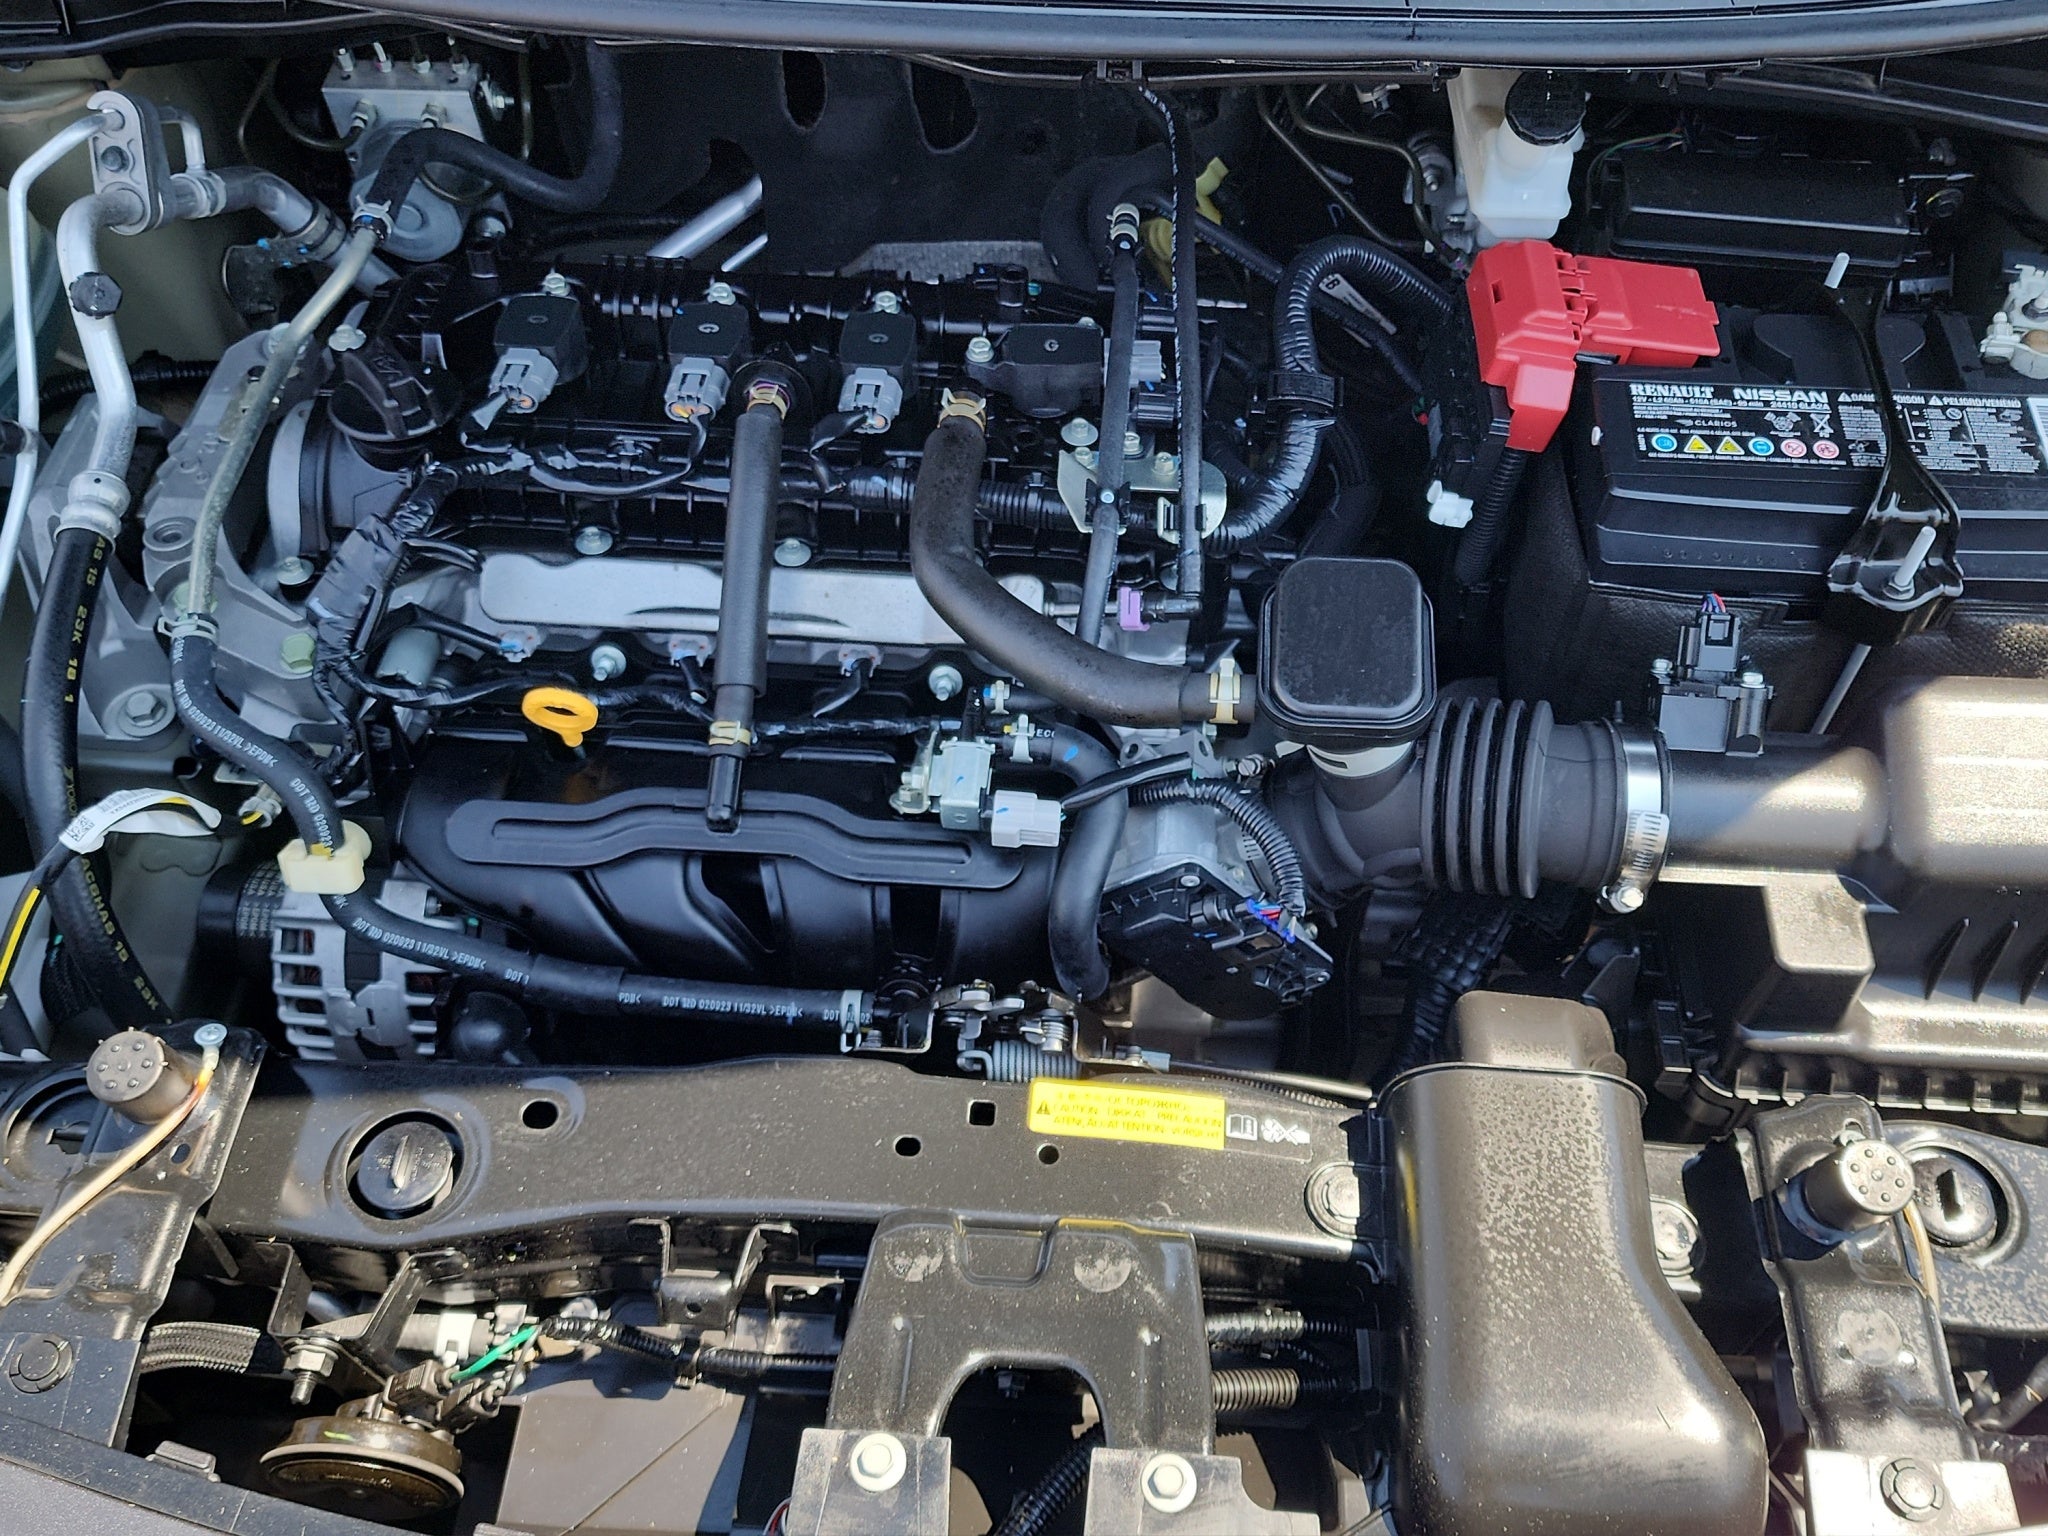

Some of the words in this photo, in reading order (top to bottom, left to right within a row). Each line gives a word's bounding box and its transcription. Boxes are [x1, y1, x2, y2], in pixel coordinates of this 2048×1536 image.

[1630, 383, 1714, 398] RENAULT
[1732, 387, 1828, 403] NISSAN
[71, 605, 88, 644] 23K
[289, 777, 310, 797] DOT
[352, 917, 370, 933] DOT
[505, 968, 523, 983] DOT
[662, 996, 680, 1008] DOT
[698, 998, 732, 1012] 020923
[824, 1009, 840, 1021] DOT
